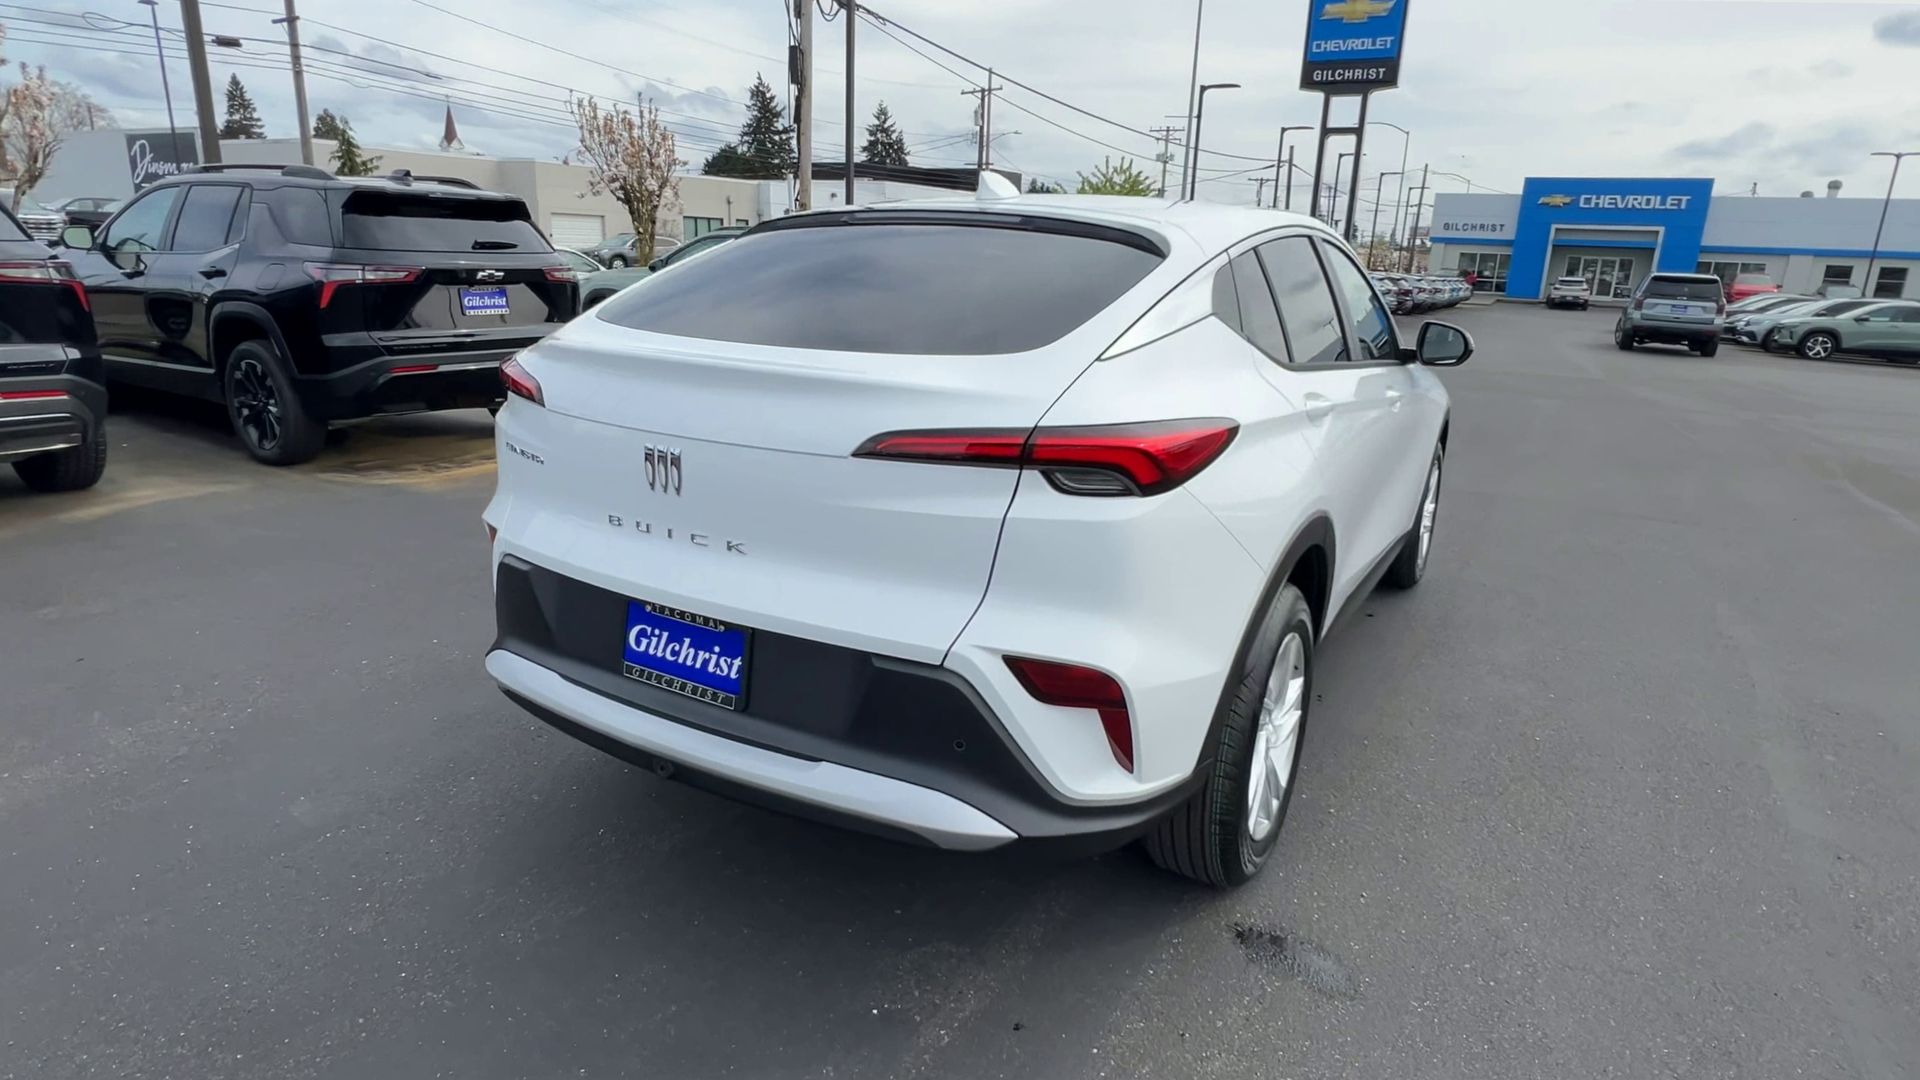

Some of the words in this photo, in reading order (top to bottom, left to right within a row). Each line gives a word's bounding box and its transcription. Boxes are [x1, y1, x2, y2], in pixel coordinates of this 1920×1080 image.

[1312, 36, 1395, 53] CHEVROLET
[1313, 68, 1386, 81] GILCHRIST
[1579, 194, 1691, 210] CHEVROLET
[1443, 222, 1505, 233] GILCHRIST
[464, 295, 507, 307] Gilchrist
[608, 514, 747, 555] BUICK
[655, 603, 715, 629] TACOMA
[628, 624, 742, 679] Gilchrist
[632, 667, 726, 703] GILCHRIST
